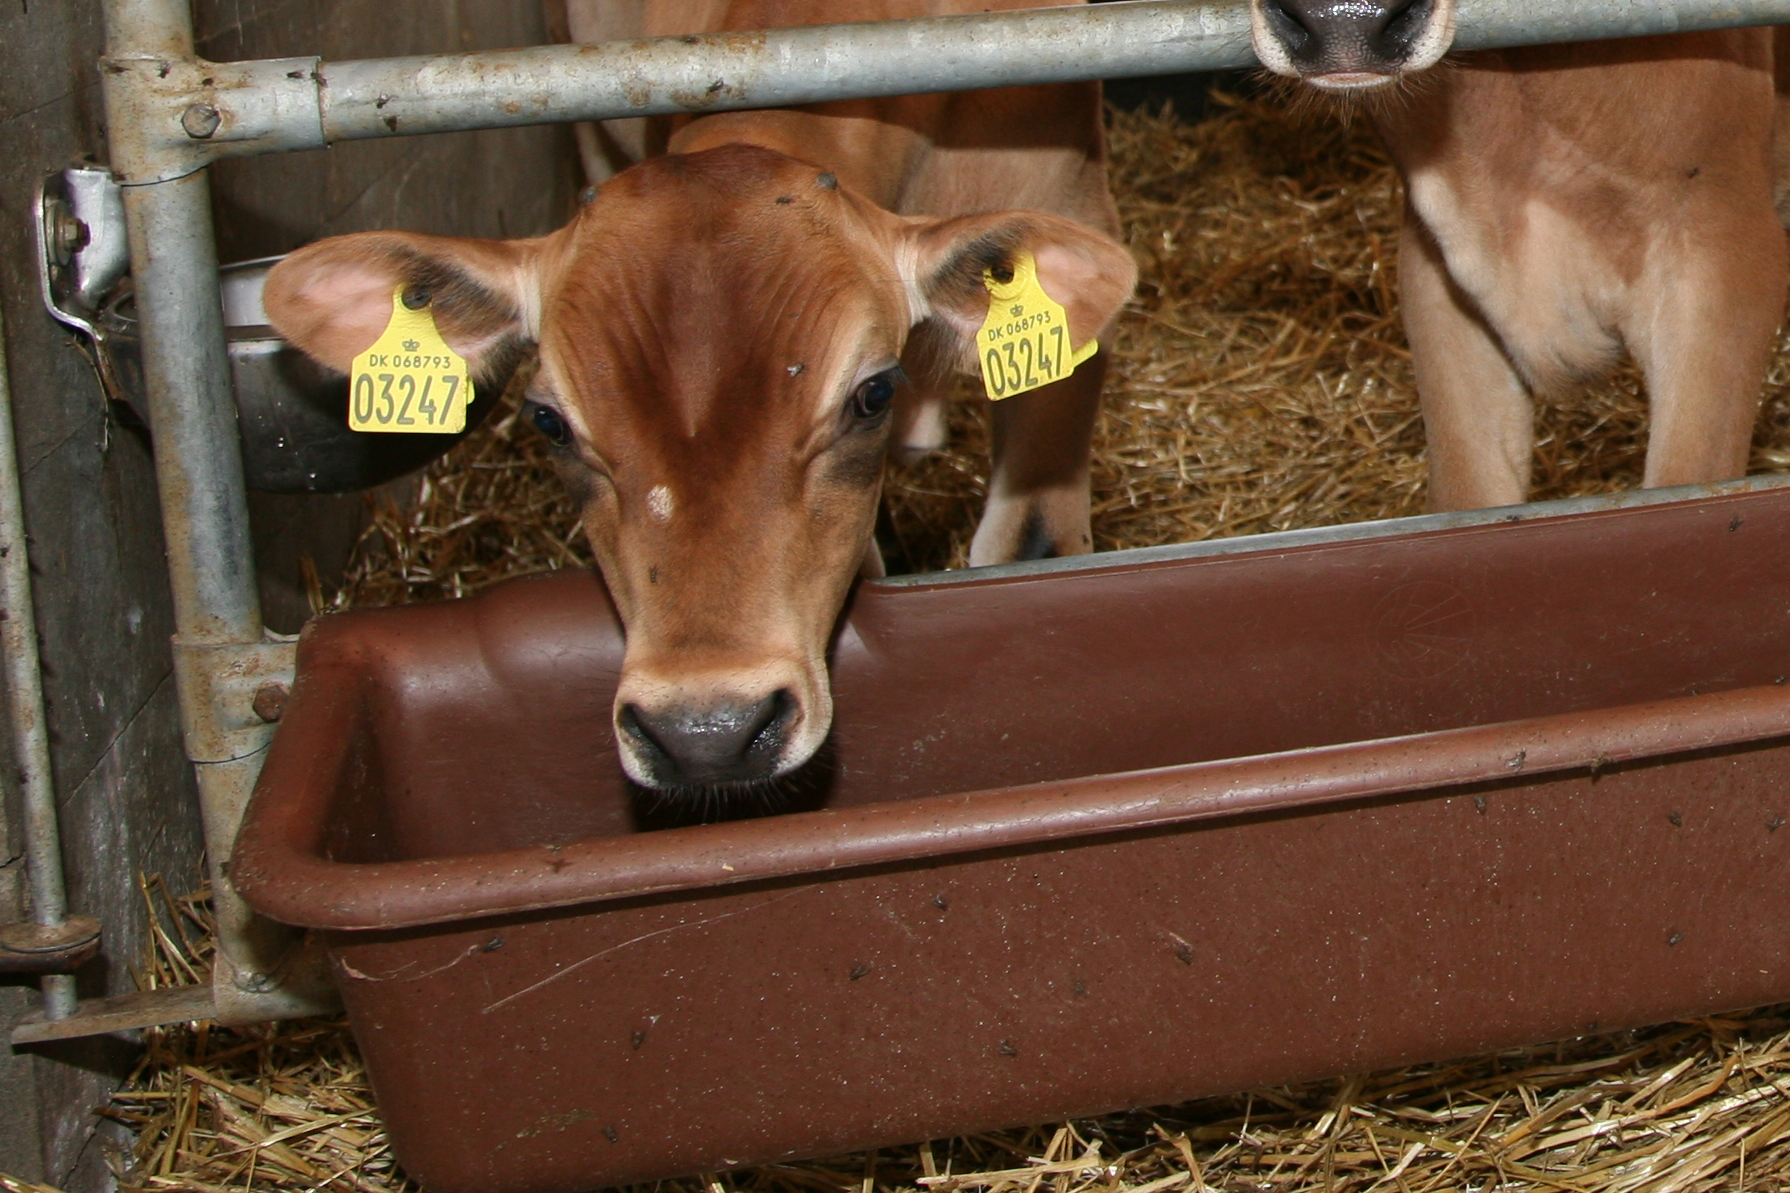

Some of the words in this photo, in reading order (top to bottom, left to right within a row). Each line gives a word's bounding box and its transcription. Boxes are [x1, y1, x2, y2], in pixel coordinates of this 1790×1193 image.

[988, 326, 1004, 342] DK
[1006, 310, 1052, 336] 068793
[369, 354, 389, 368] DK
[392, 354, 452, 369] 068793
[986, 324, 1063, 396] 03247
[354, 372, 460, 426] 03247
